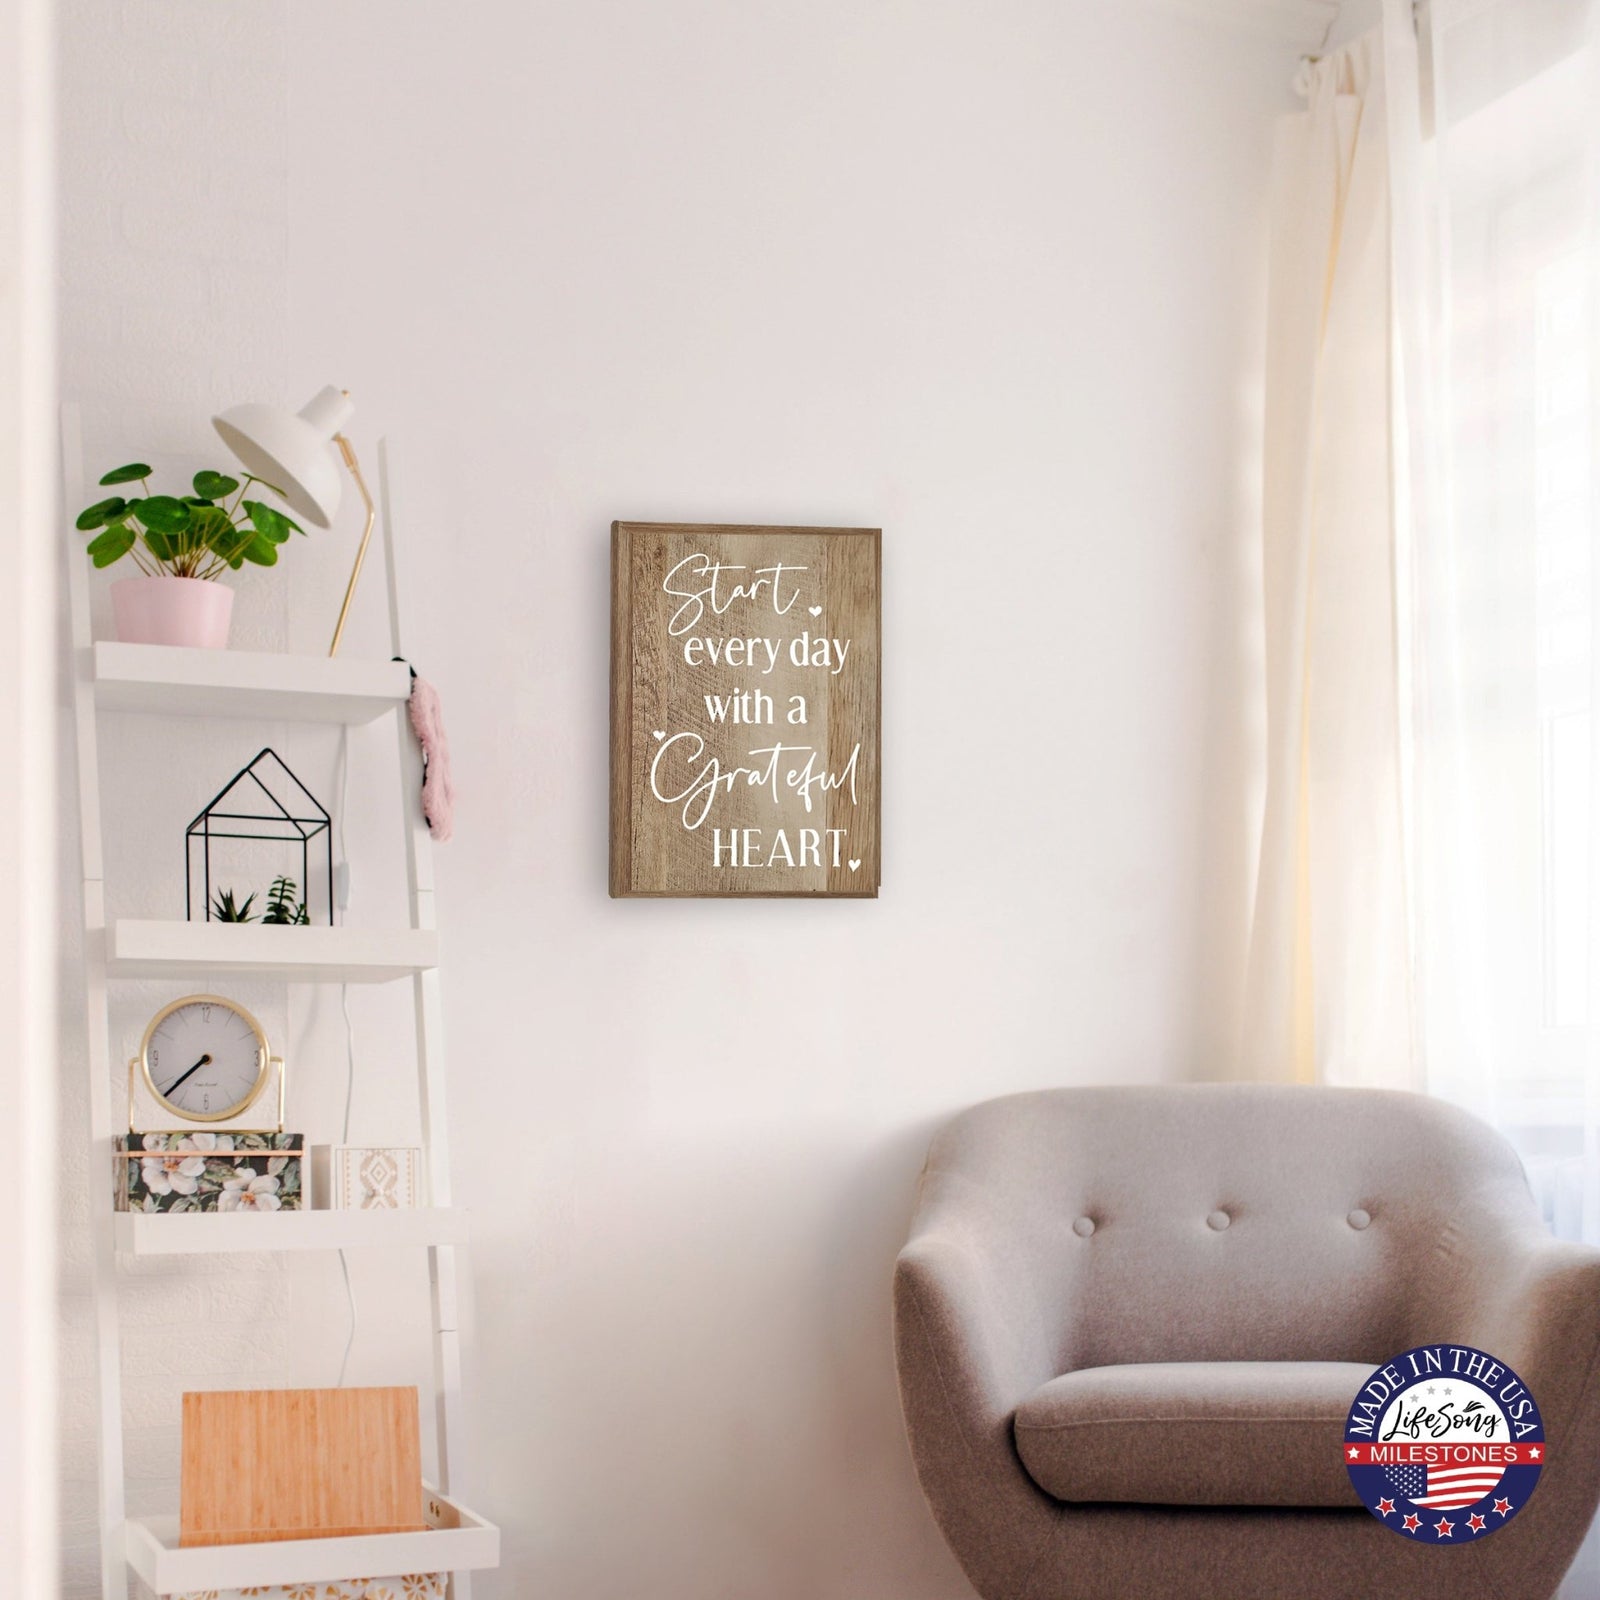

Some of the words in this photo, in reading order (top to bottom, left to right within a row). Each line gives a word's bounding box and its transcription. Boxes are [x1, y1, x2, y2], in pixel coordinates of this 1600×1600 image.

[663, 553, 808, 636] Start
[684, 636, 782, 674] every
[789, 632, 851, 674] day
[703, 688, 773, 725] with
[787, 695, 807, 725] a
[650, 732, 860, 830] Grateful
[712, 829, 847, 867] HEART
